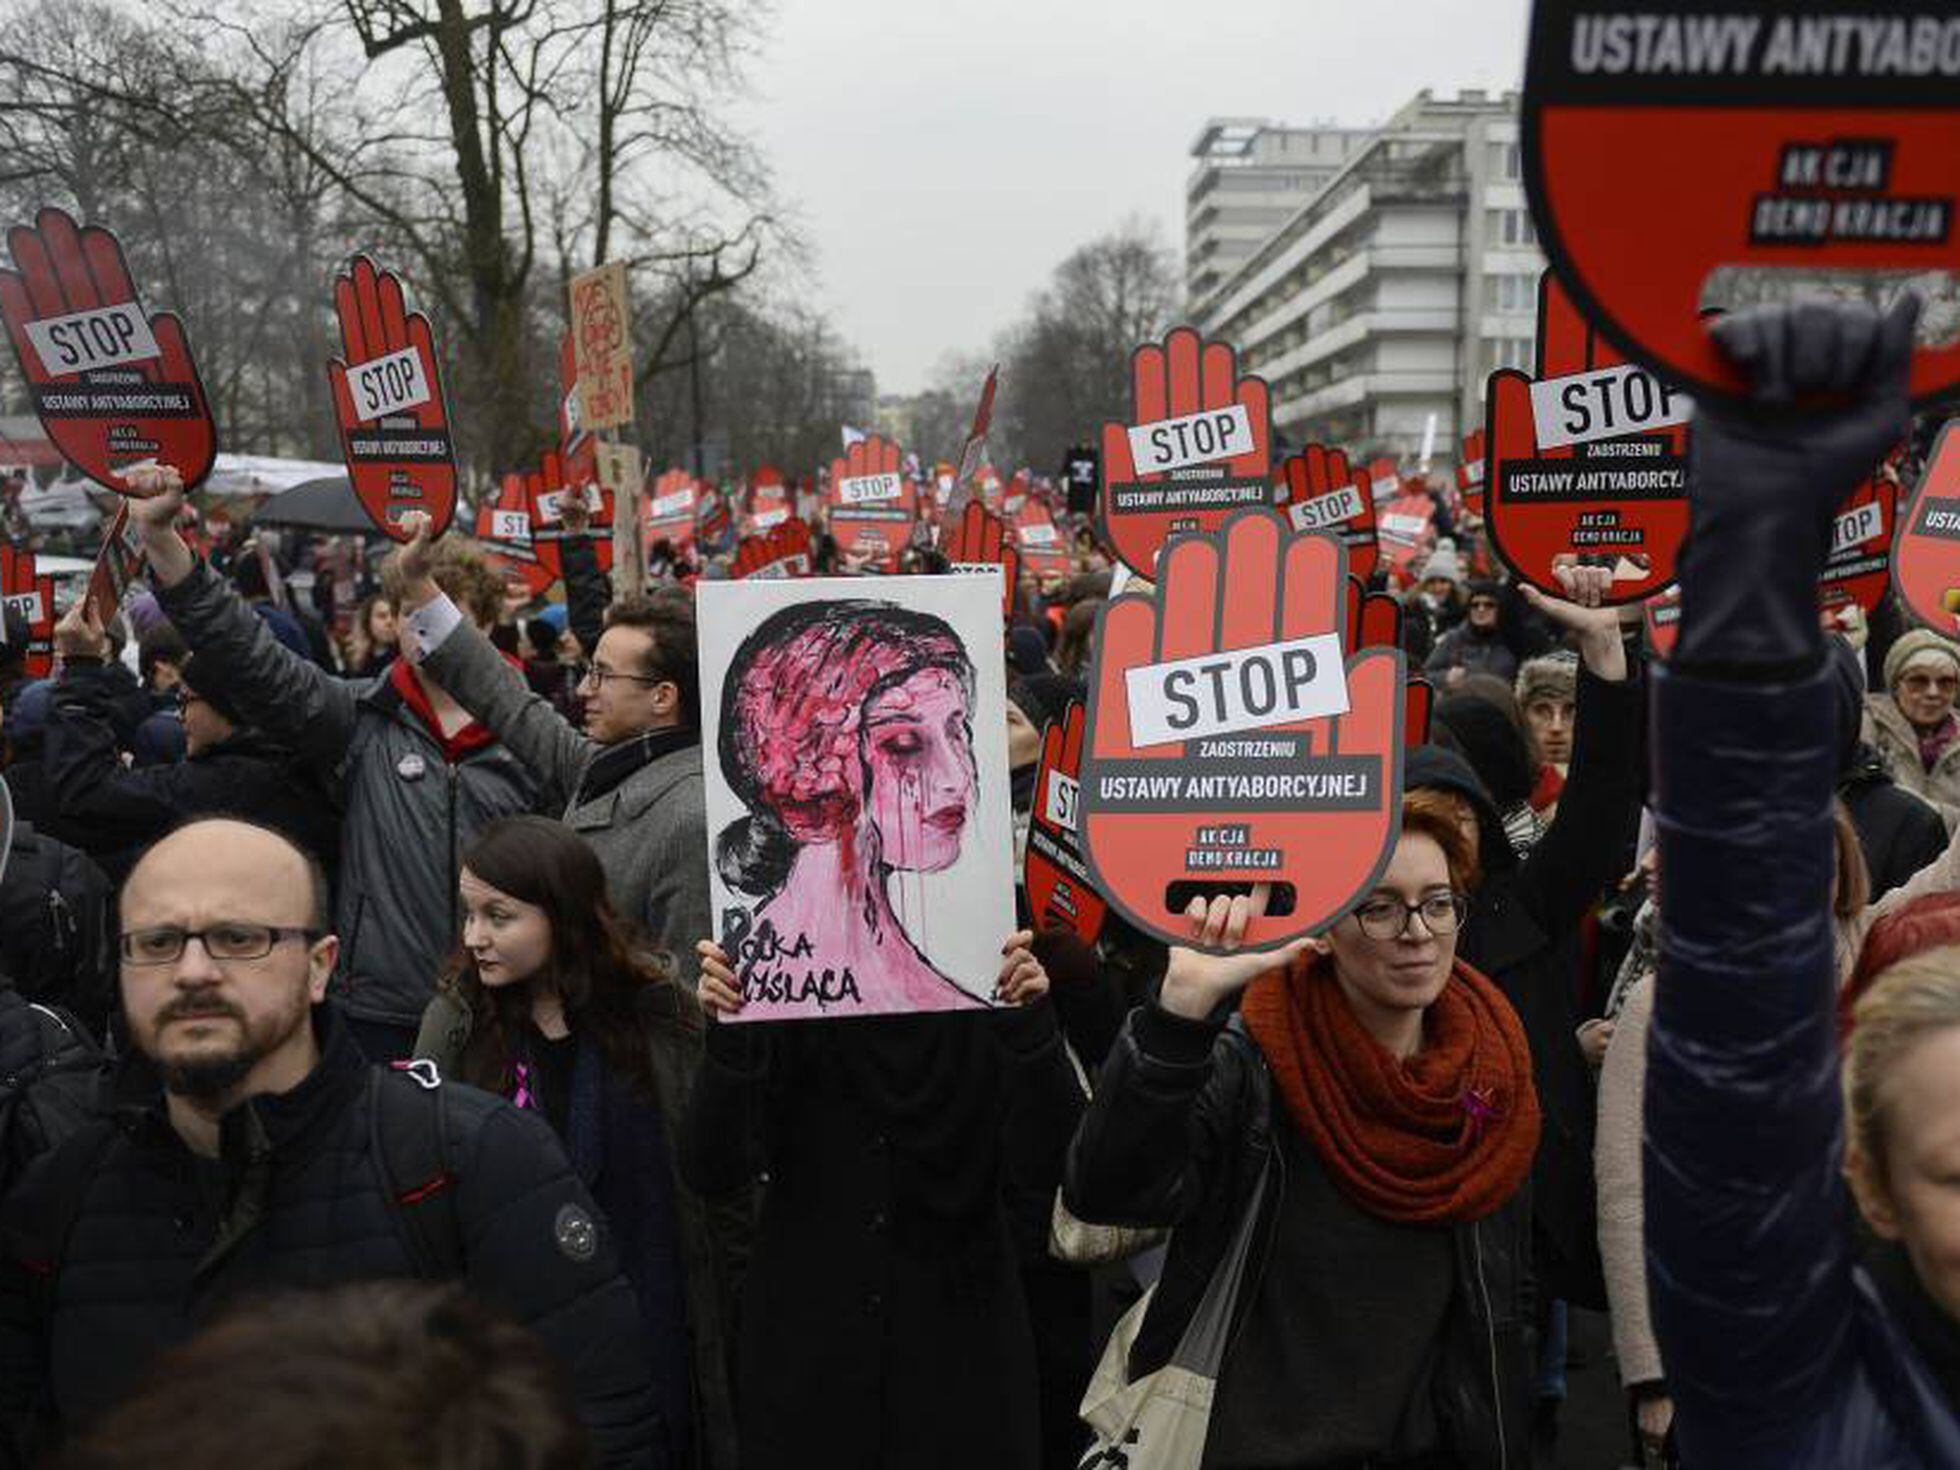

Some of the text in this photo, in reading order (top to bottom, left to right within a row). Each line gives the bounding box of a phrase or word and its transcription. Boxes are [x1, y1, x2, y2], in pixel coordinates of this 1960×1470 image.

[1570, 13, 1760, 75] USTAWY
[50, 313, 134, 365] STOP
[362, 357, 414, 409] STOP
[1151, 414, 1236, 464] STOP
[850, 477, 893, 498] STOP
[1510, 473, 1573, 493] USTAWY
[1302, 491, 1353, 527] STOP
[1163, 648, 1318, 729] STOP
[1200, 741, 1296, 758] ZAOSTRZENIU
[1100, 774, 1367, 799] USTAWY ANTYABORCYJNEJ
[1200, 830, 1245, 844] AKCJA
[1189, 851, 1278, 867] DEMOKRACJA
